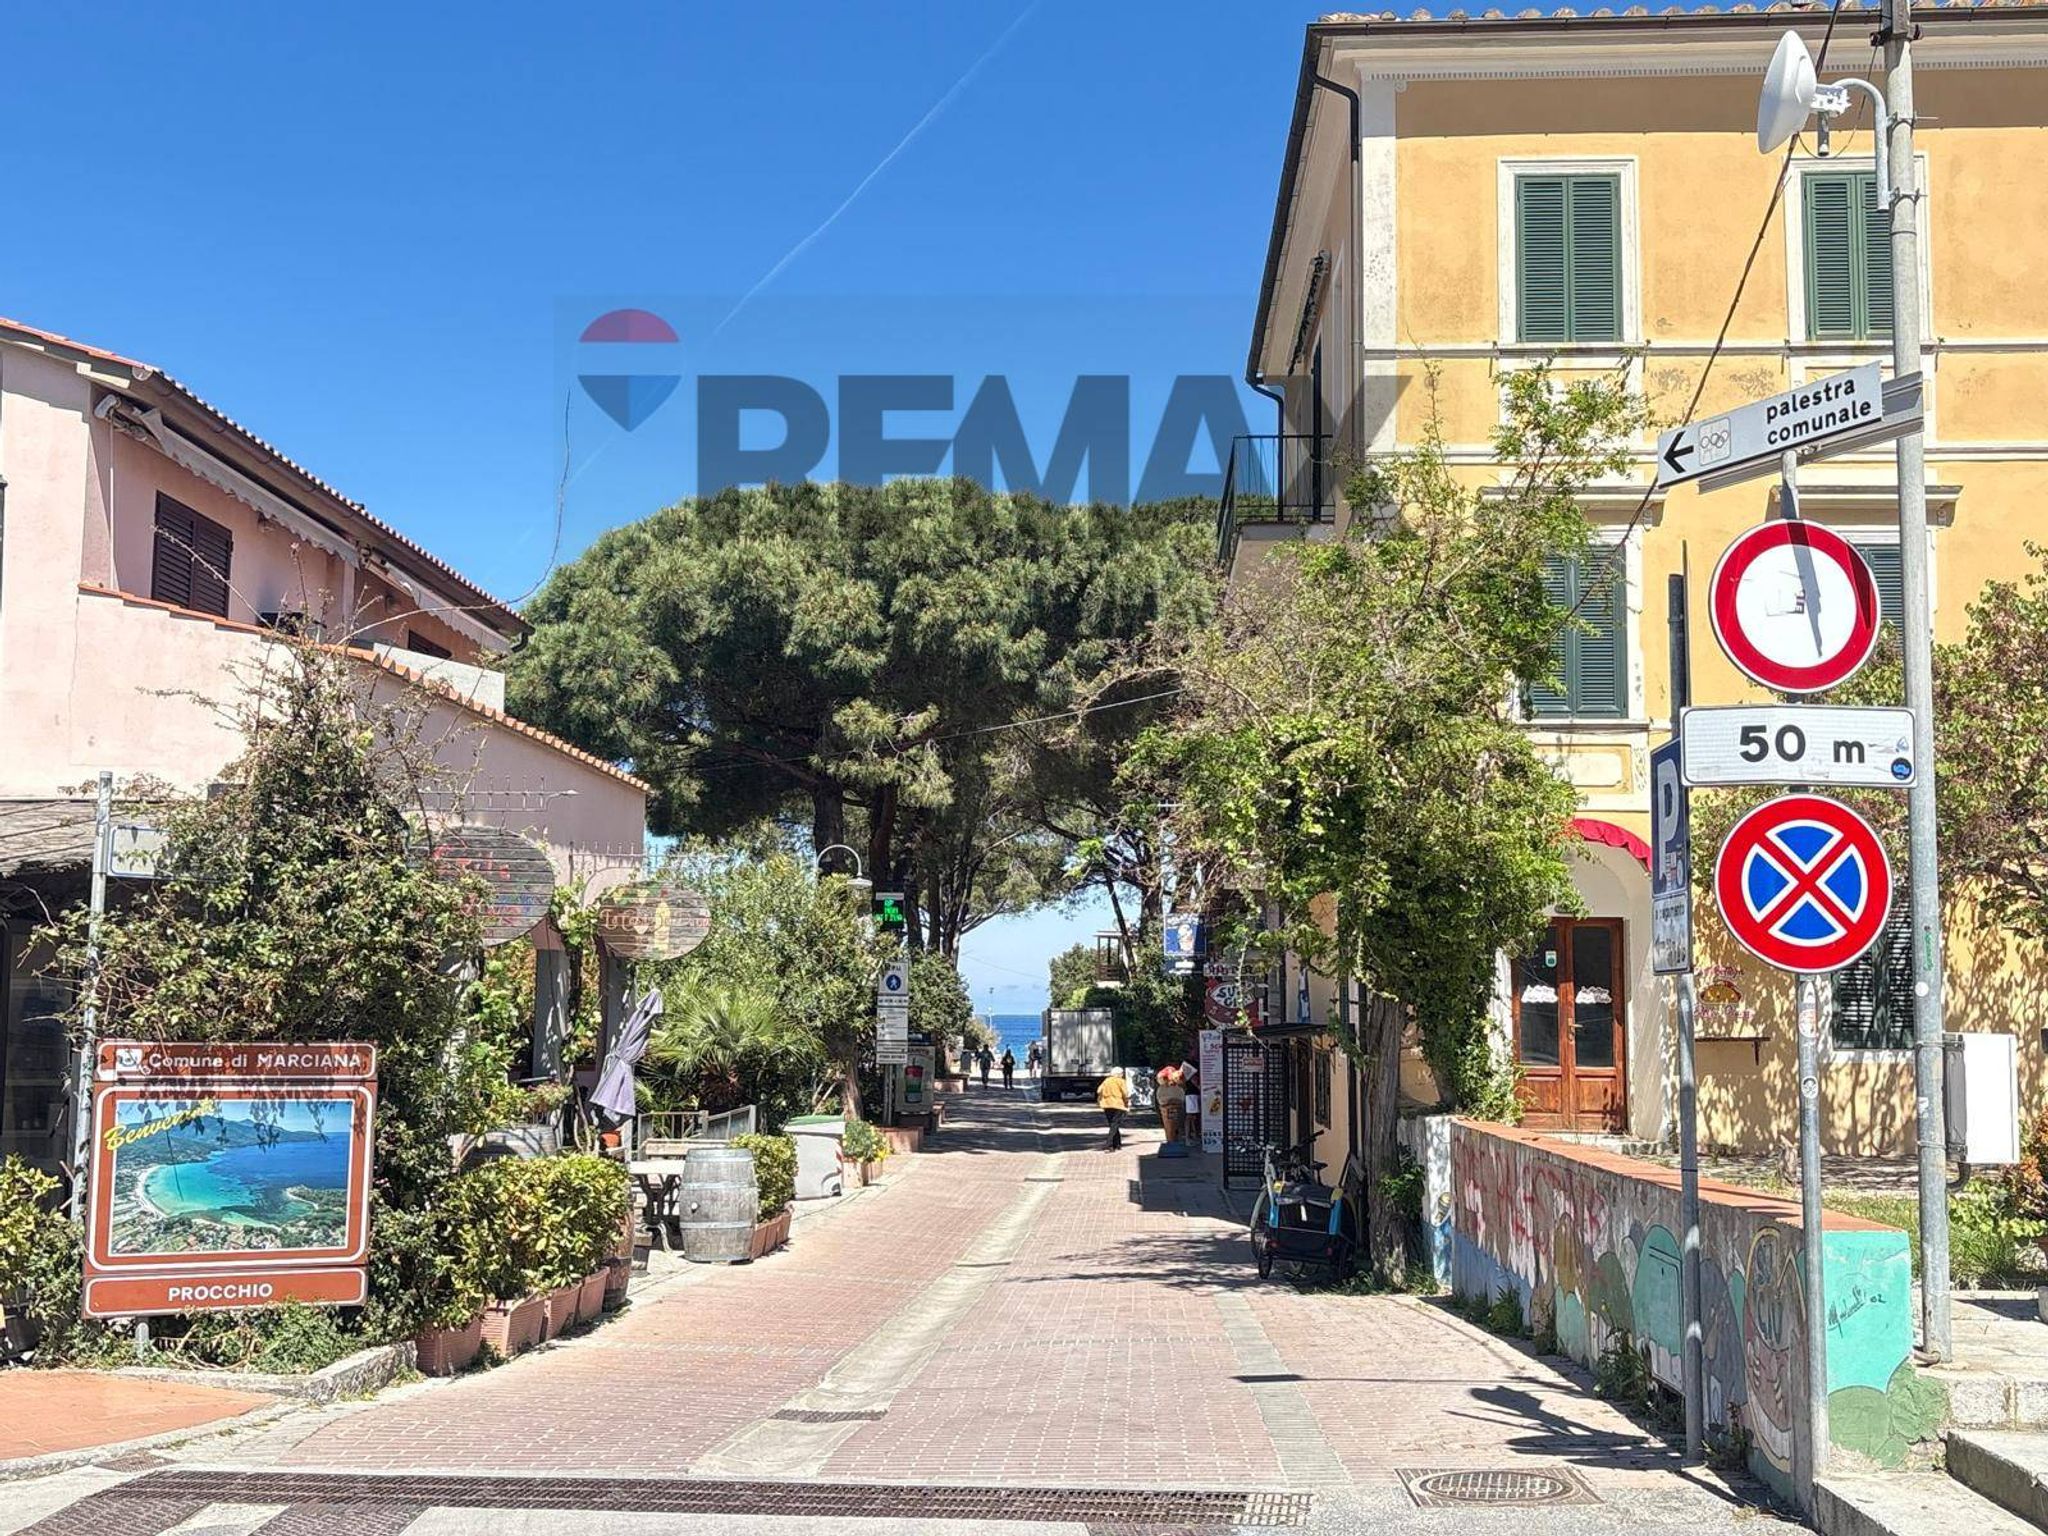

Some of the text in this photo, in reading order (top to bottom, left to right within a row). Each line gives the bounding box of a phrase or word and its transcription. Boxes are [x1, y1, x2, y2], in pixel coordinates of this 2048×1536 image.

[1766, 379, 1855, 424] palestra
[1767, 400, 1872, 445] comunale
[1739, 724, 1866, 764] 50 m
[1657, 758, 1680, 881] P
[149, 1053, 362, 1069] Comune di MARCIANA
[168, 1283, 273, 1302] PROCCHIO
